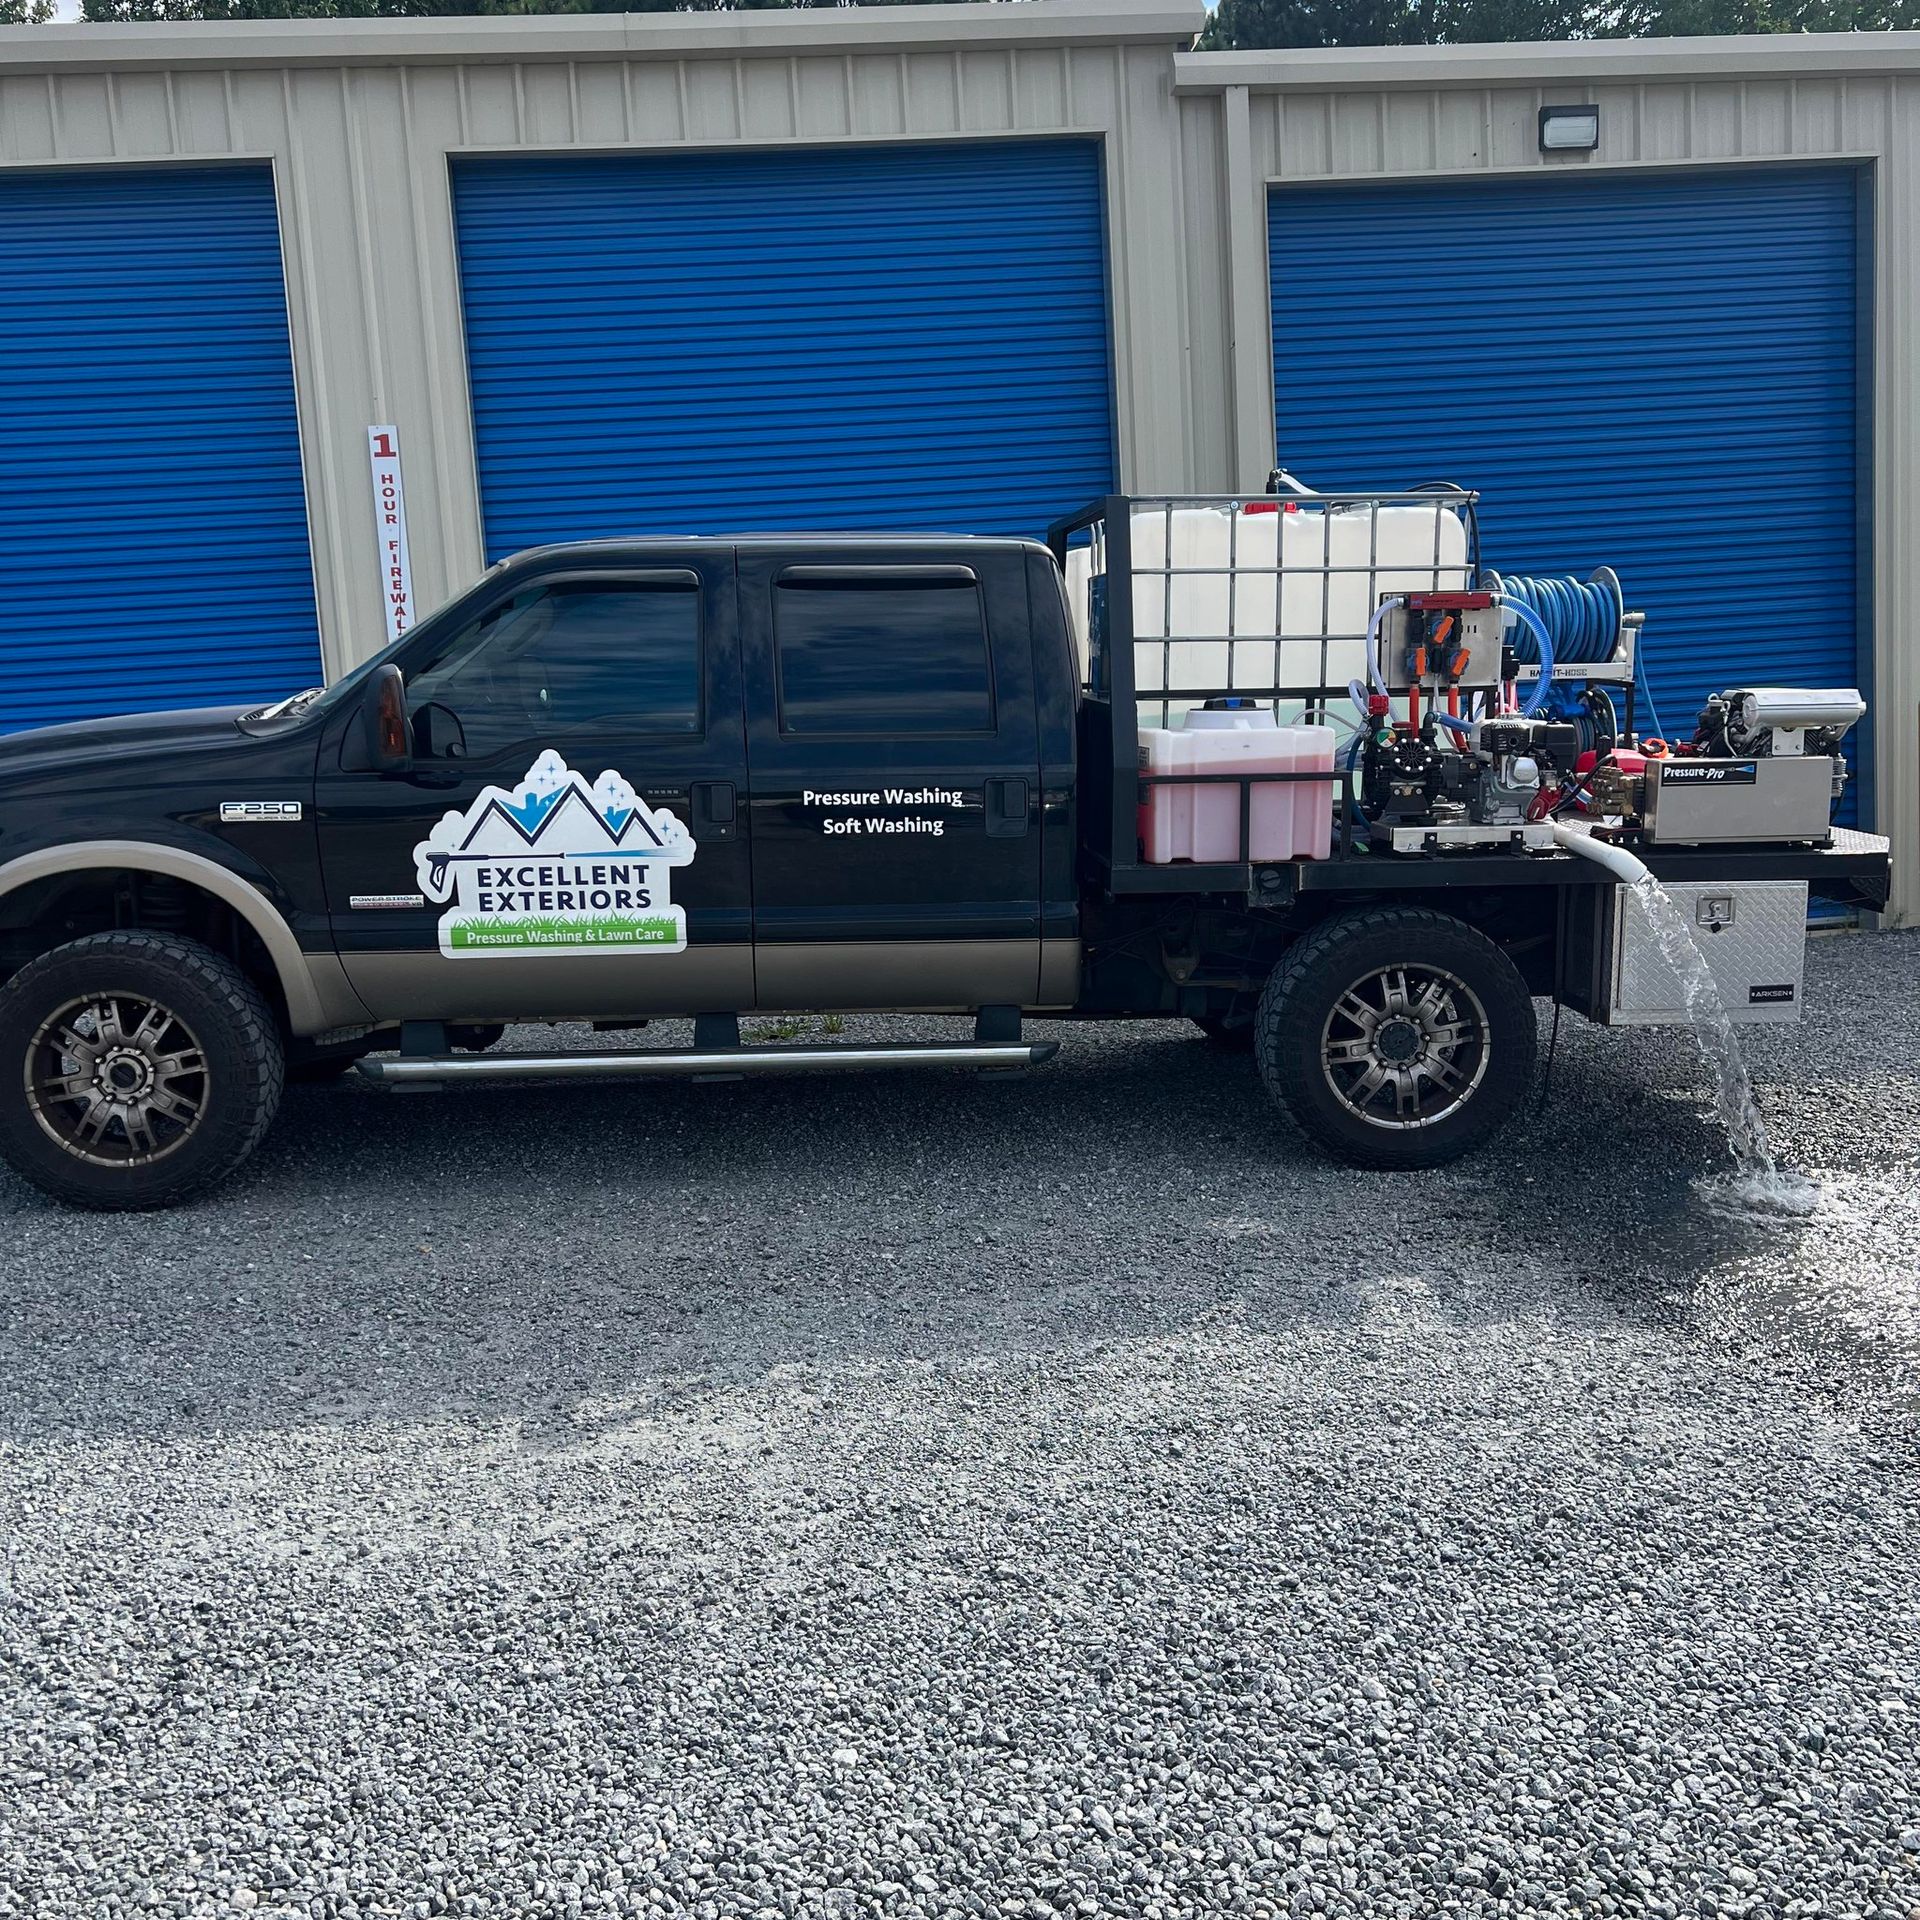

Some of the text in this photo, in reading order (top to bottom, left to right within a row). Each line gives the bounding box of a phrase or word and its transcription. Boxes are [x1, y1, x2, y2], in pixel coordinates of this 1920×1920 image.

[373, 433, 397, 457] 1
[381, 474, 397, 524] HOUR
[388, 540, 406, 636] FIREWAL
[1664, 767, 1725, 779] Pressure-Pro
[803, 787, 963, 807] Pressure Washing
[823, 816, 944, 836] Soft Washing
[477, 865, 650, 887] EXCELLENT
[478, 889, 652, 912] EXTERIORS
[467, 928, 665, 944] Pressure Washing & Lawn Care
